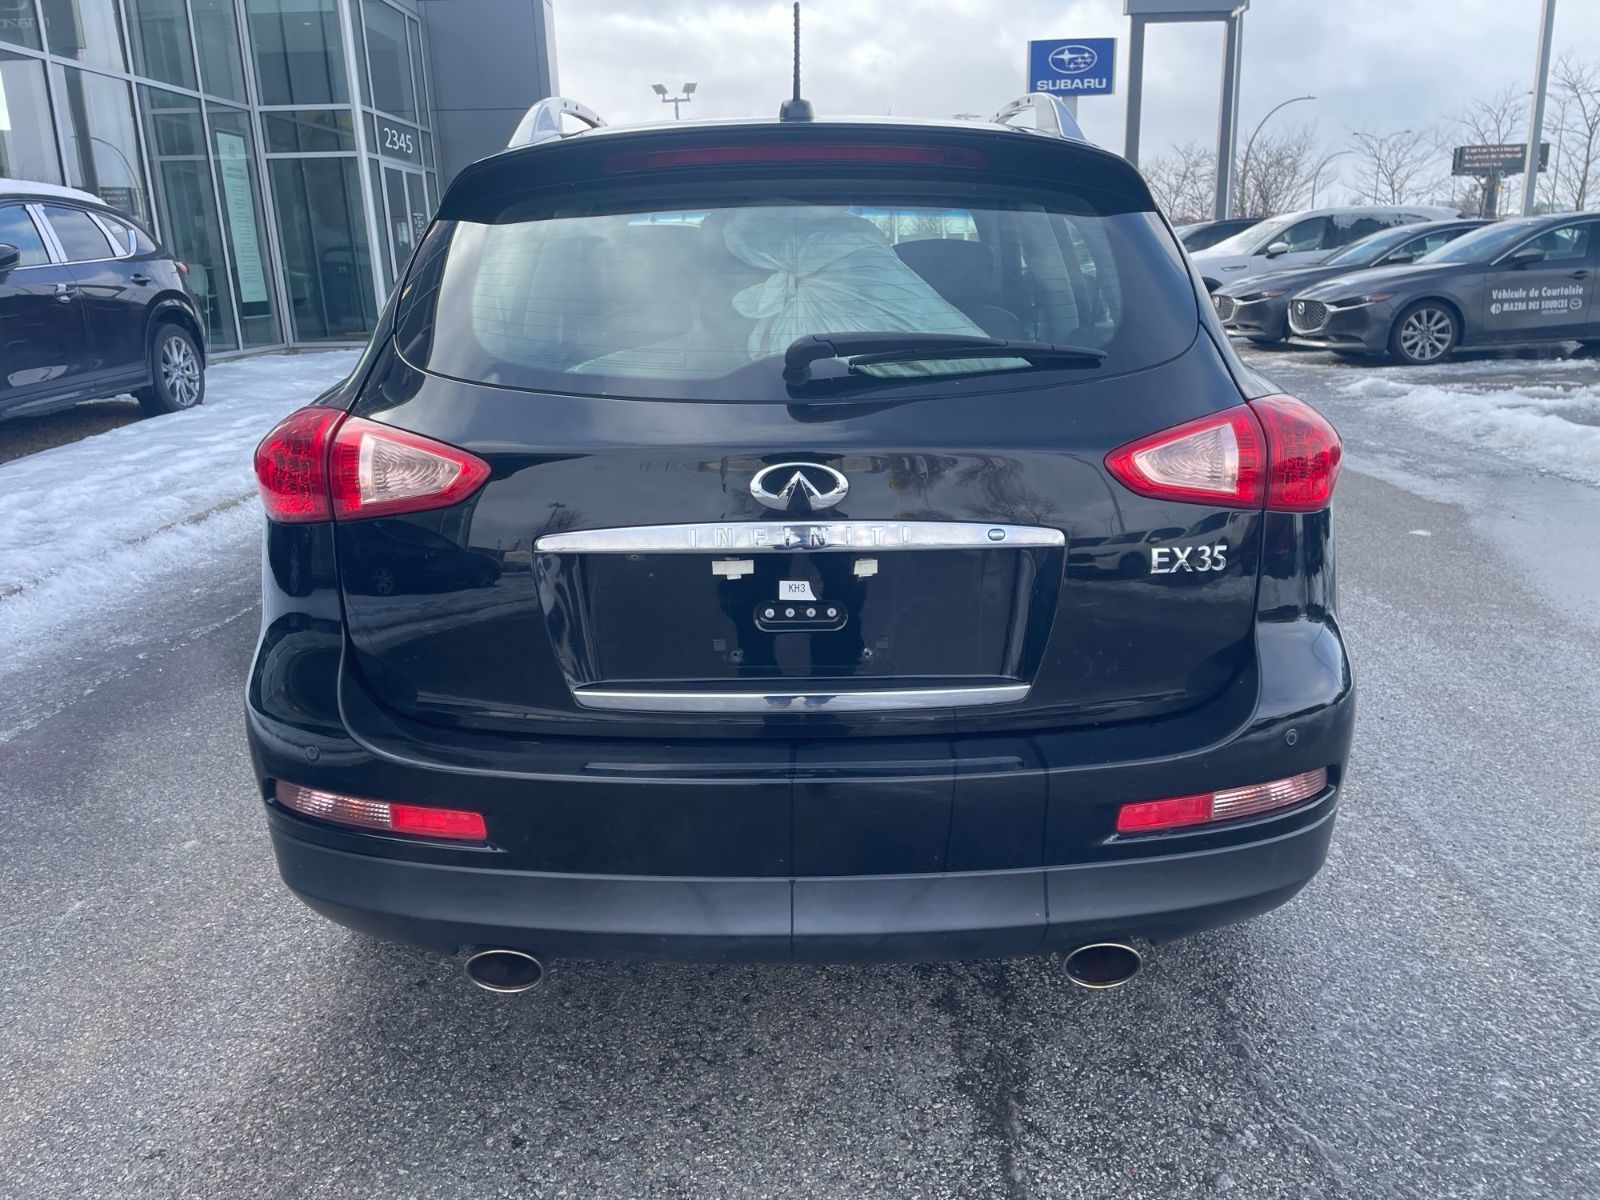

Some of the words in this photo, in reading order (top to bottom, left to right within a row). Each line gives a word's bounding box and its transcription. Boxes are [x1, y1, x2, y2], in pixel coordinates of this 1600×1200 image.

[1036, 78, 1107, 91] SUBARU
[384, 128, 413, 154] 2345
[1492, 287, 1527, 300] Véhicule
[1529, 287, 1539, 298] de
[1541, 284, 1584, 297] Courtoisie
[1503, 302, 1527, 312] MAZDA
[1528, 300, 1540, 311] DES
[1541, 299, 1569, 309] SOURCES
[688, 526, 910, 548] INFINITI
[1150, 545, 1228, 574] EX35
[788, 583, 806, 593] KH3
